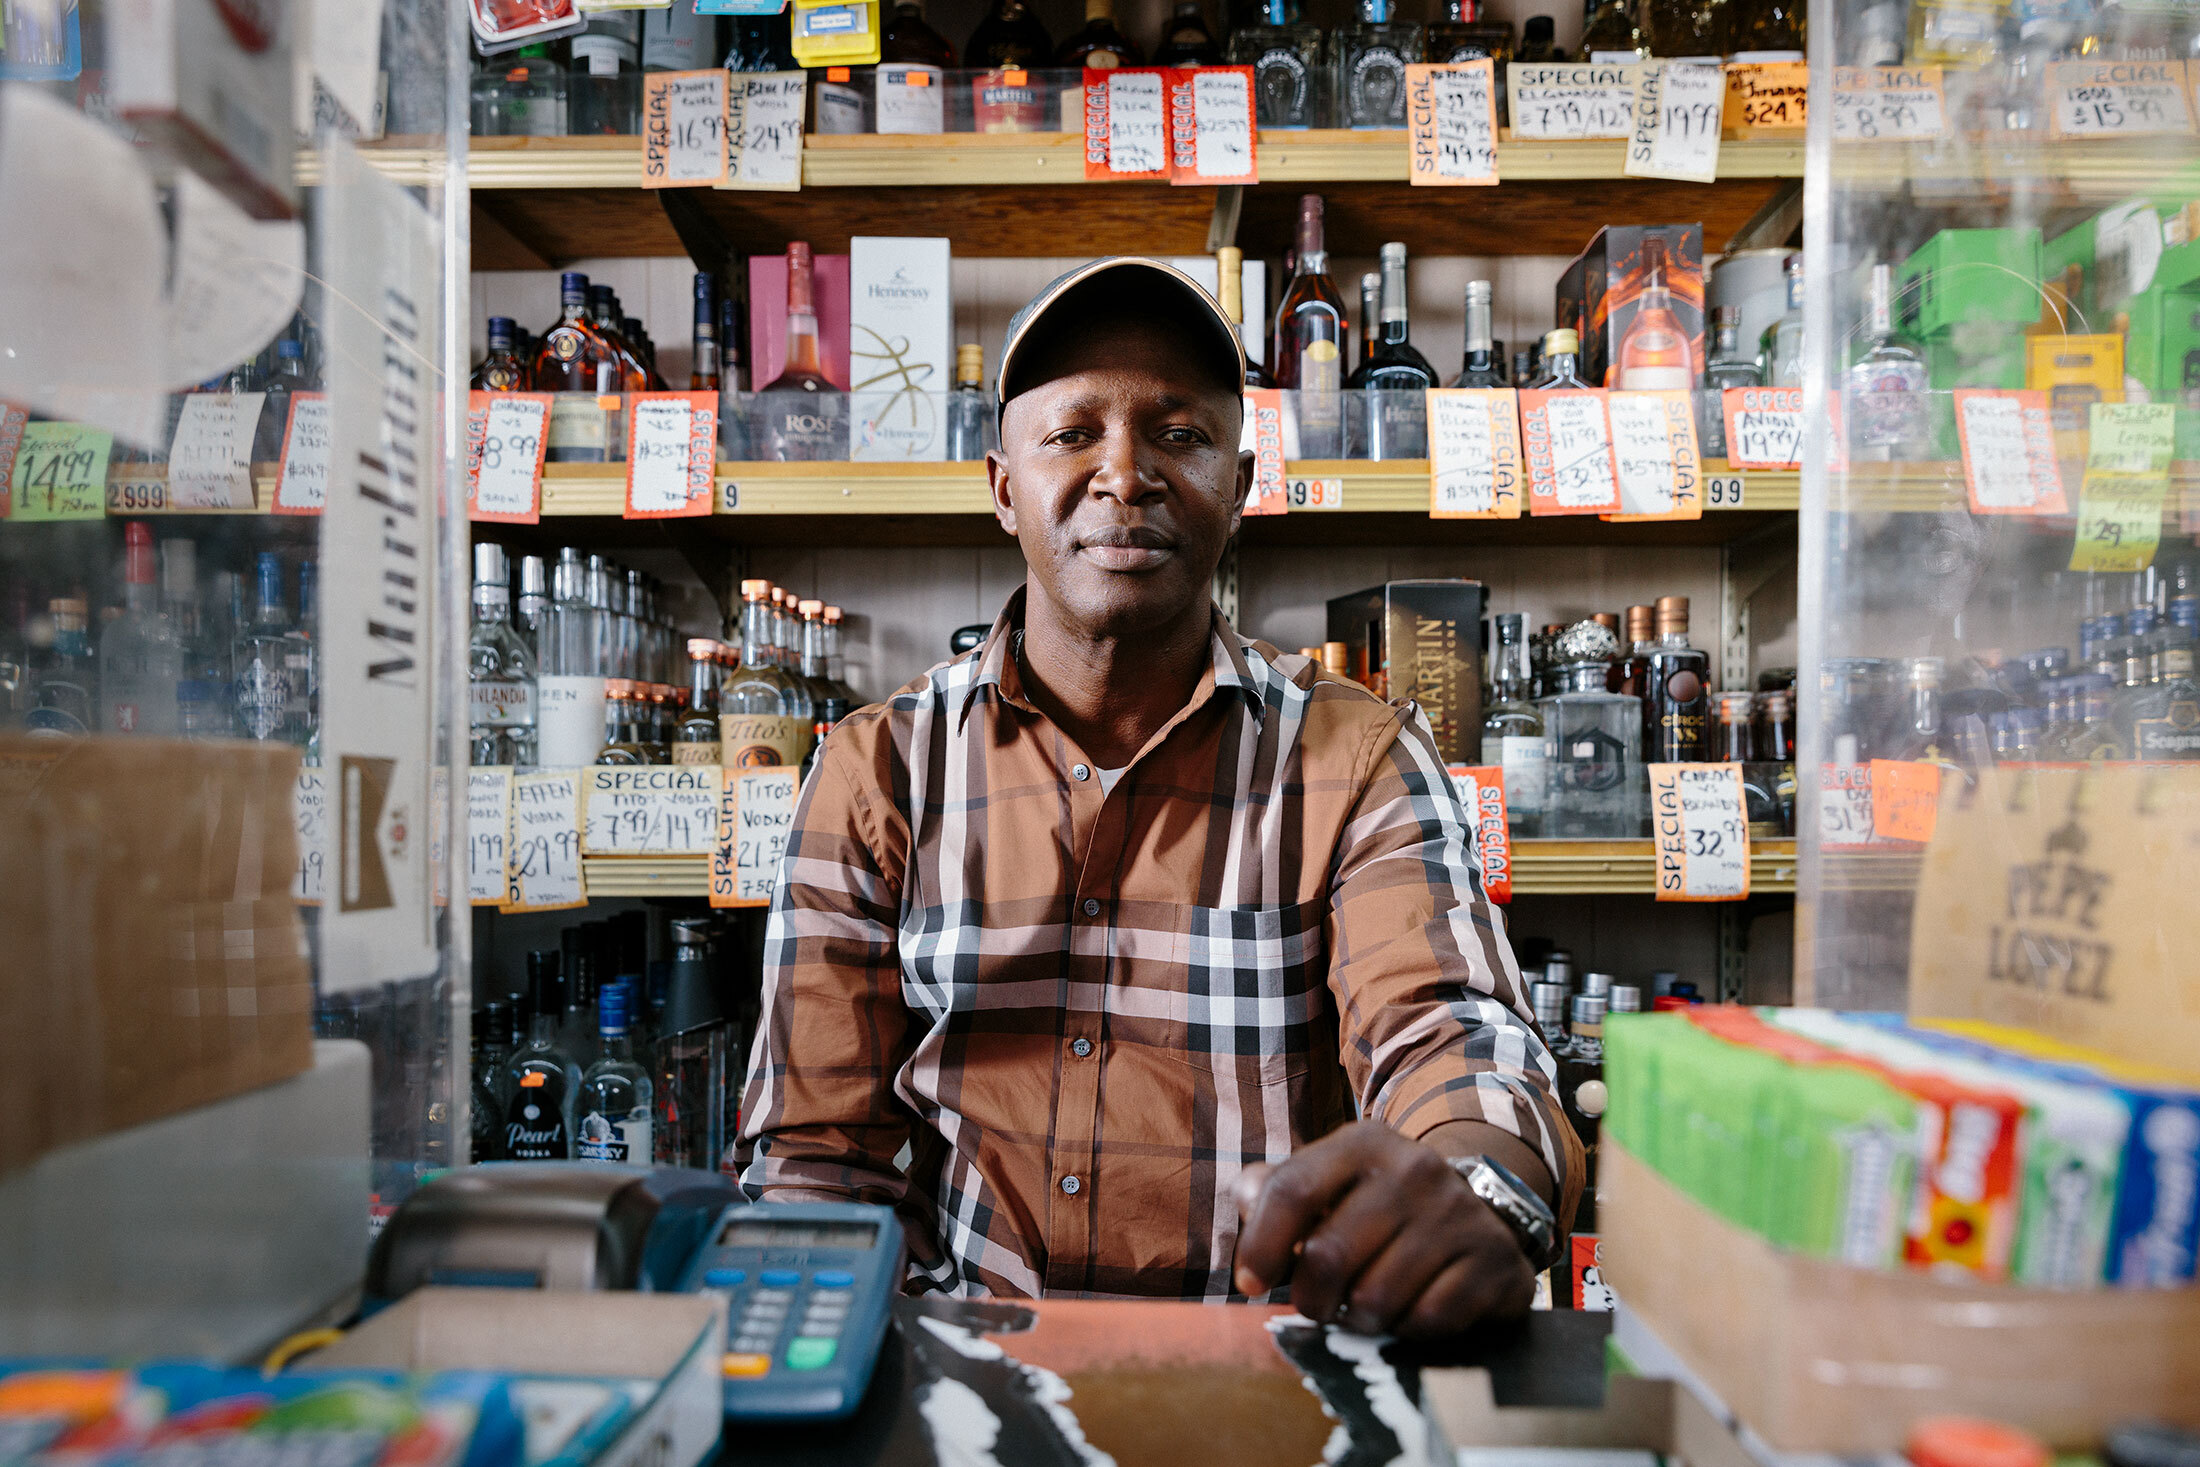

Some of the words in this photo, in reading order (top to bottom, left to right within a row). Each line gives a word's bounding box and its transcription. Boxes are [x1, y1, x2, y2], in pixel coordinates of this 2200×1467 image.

[1087, 82, 1107, 164] SPECIAL
[1522, 70, 1632, 85] SPECIAL
[1634, 66, 1661, 162] SPECIAL
[648, 83, 668, 177] SPECIAL
[1173, 82, 1195, 168] SPECIAL
[1415, 75, 1434, 173] SPECIAL
[868, 283, 931, 301] Hennessy
[107, 484, 165, 509] 2999
[690, 408, 714, 501] SPECIAL
[1257, 406, 1284, 498] SPECIAL
[1491, 400, 1516, 505] SPECIAL
[1526, 406, 1554, 498] SPECIAL
[1668, 400, 1696, 507] SPECIAL
[1710, 479, 1742, 504] 99
[730, 719, 789, 740] Tito's
[518, 779, 575, 804] EFFEN
[595, 771, 712, 790] SPECIAL
[714, 781, 734, 896] SPECIAL
[1480, 786, 1508, 888] SPECIAL
[1658, 775, 1683, 891] SPECIAL
[505, 1121, 562, 1150] Pearl
